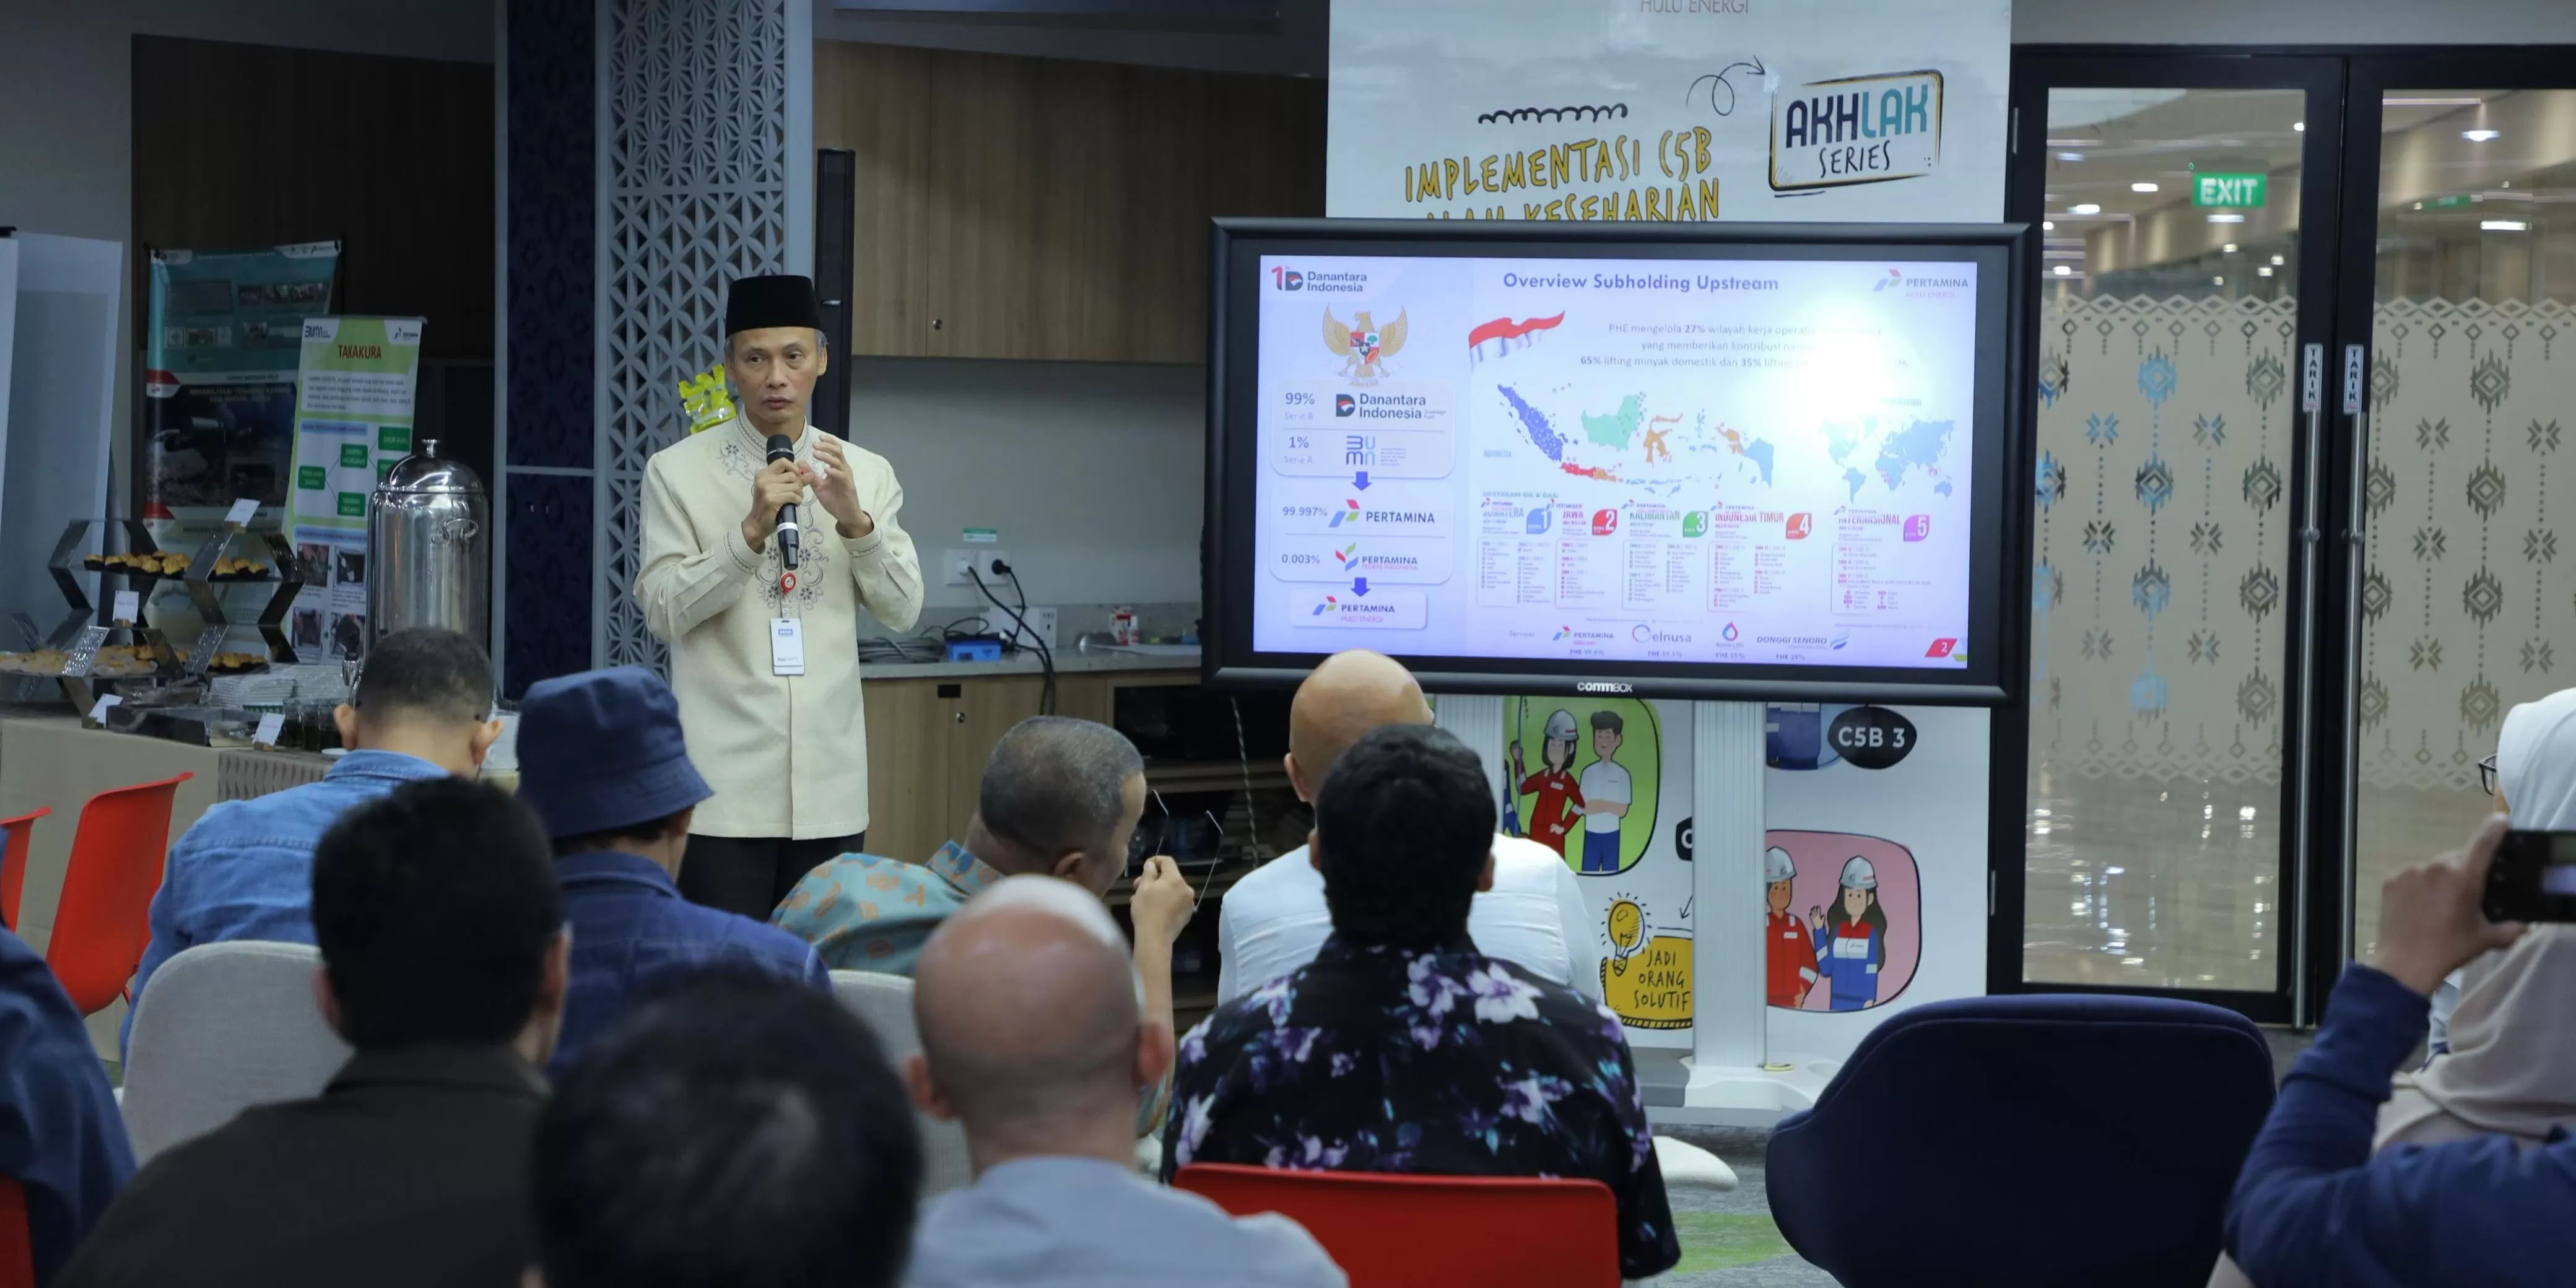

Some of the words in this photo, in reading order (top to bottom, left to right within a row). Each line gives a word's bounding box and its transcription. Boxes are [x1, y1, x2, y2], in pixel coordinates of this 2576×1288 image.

[1689, 0, 1748, 13] ENERGI
[1786, 84, 1928, 148] AKHLAK
[1406, 135, 1640, 202] IMPLEMENTASI
[1659, 126, 1712, 181] C5B
[1819, 139, 1891, 178] SERIES
[2201, 177, 2258, 206] EXIT
[1307, 271, 1367, 282] Danantara
[1503, 272, 1587, 289] Overview
[1593, 273, 1690, 292] Subholding
[1697, 275, 1778, 293] Upstream
[1907, 278, 1969, 288] PERTAMINA
[1307, 282, 1364, 292] Indonesia
[1609, 323, 1628, 333] PHE
[1631, 324, 1682, 335] mengelola
[1684, 324, 1705, 334] 27%
[1708, 324, 1745, 336] wilayah
[1748, 325, 1772, 336] kerja
[338, 344, 381, 360] TAKAKURA
[1641, 342, 1664, 352] yang
[1667, 341, 1729, 351] memberikan
[1731, 342, 1781, 351] kontribusi
[1580, 356, 1602, 365] 65%
[1604, 356, 1632, 367] lifting
[1634, 357, 1669, 368] minyak
[1671, 357, 1717, 367] domestik
[1720, 358, 1738, 367] dan
[1741, 358, 1762, 367] 35%
[1285, 392, 1315, 405] 99%
[1359, 393, 1426, 406] Danantara
[1359, 407, 1422, 419] Indonesia
[1289, 436, 1309, 448] 1%
[1282, 507, 1328, 517] 99.997%
[1366, 511, 1435, 523] PERTAMINA
[1541, 510, 1548, 529] 1
[1562, 511, 1584, 519] JAWA
[1605, 510, 1615, 531] 2
[1696, 511, 1706, 534] 3
[1760, 511, 1784, 523] TIMUR
[1799, 514, 1810, 535] 4
[1917, 515, 1927, 537] 5
[1281, 554, 1321, 564] 0.003%
[1362, 555, 1418, 565] PERTAMINA
[1341, 604, 1396, 613] PERTAMINA
[1573, 632, 1614, 640] PERTAMINA
[1651, 631, 1692, 643] elnusa
[1793, 637, 1827, 645] SENORO
[1941, 642, 1949, 653] 2
[1838, 725, 1884, 748] C5B
[1892, 727, 1905, 747] 3
[1647, 949, 1676, 967] JADI
[1638, 970, 1685, 989] ORANG
[1634, 990, 1691, 1011] SOLUTIF
